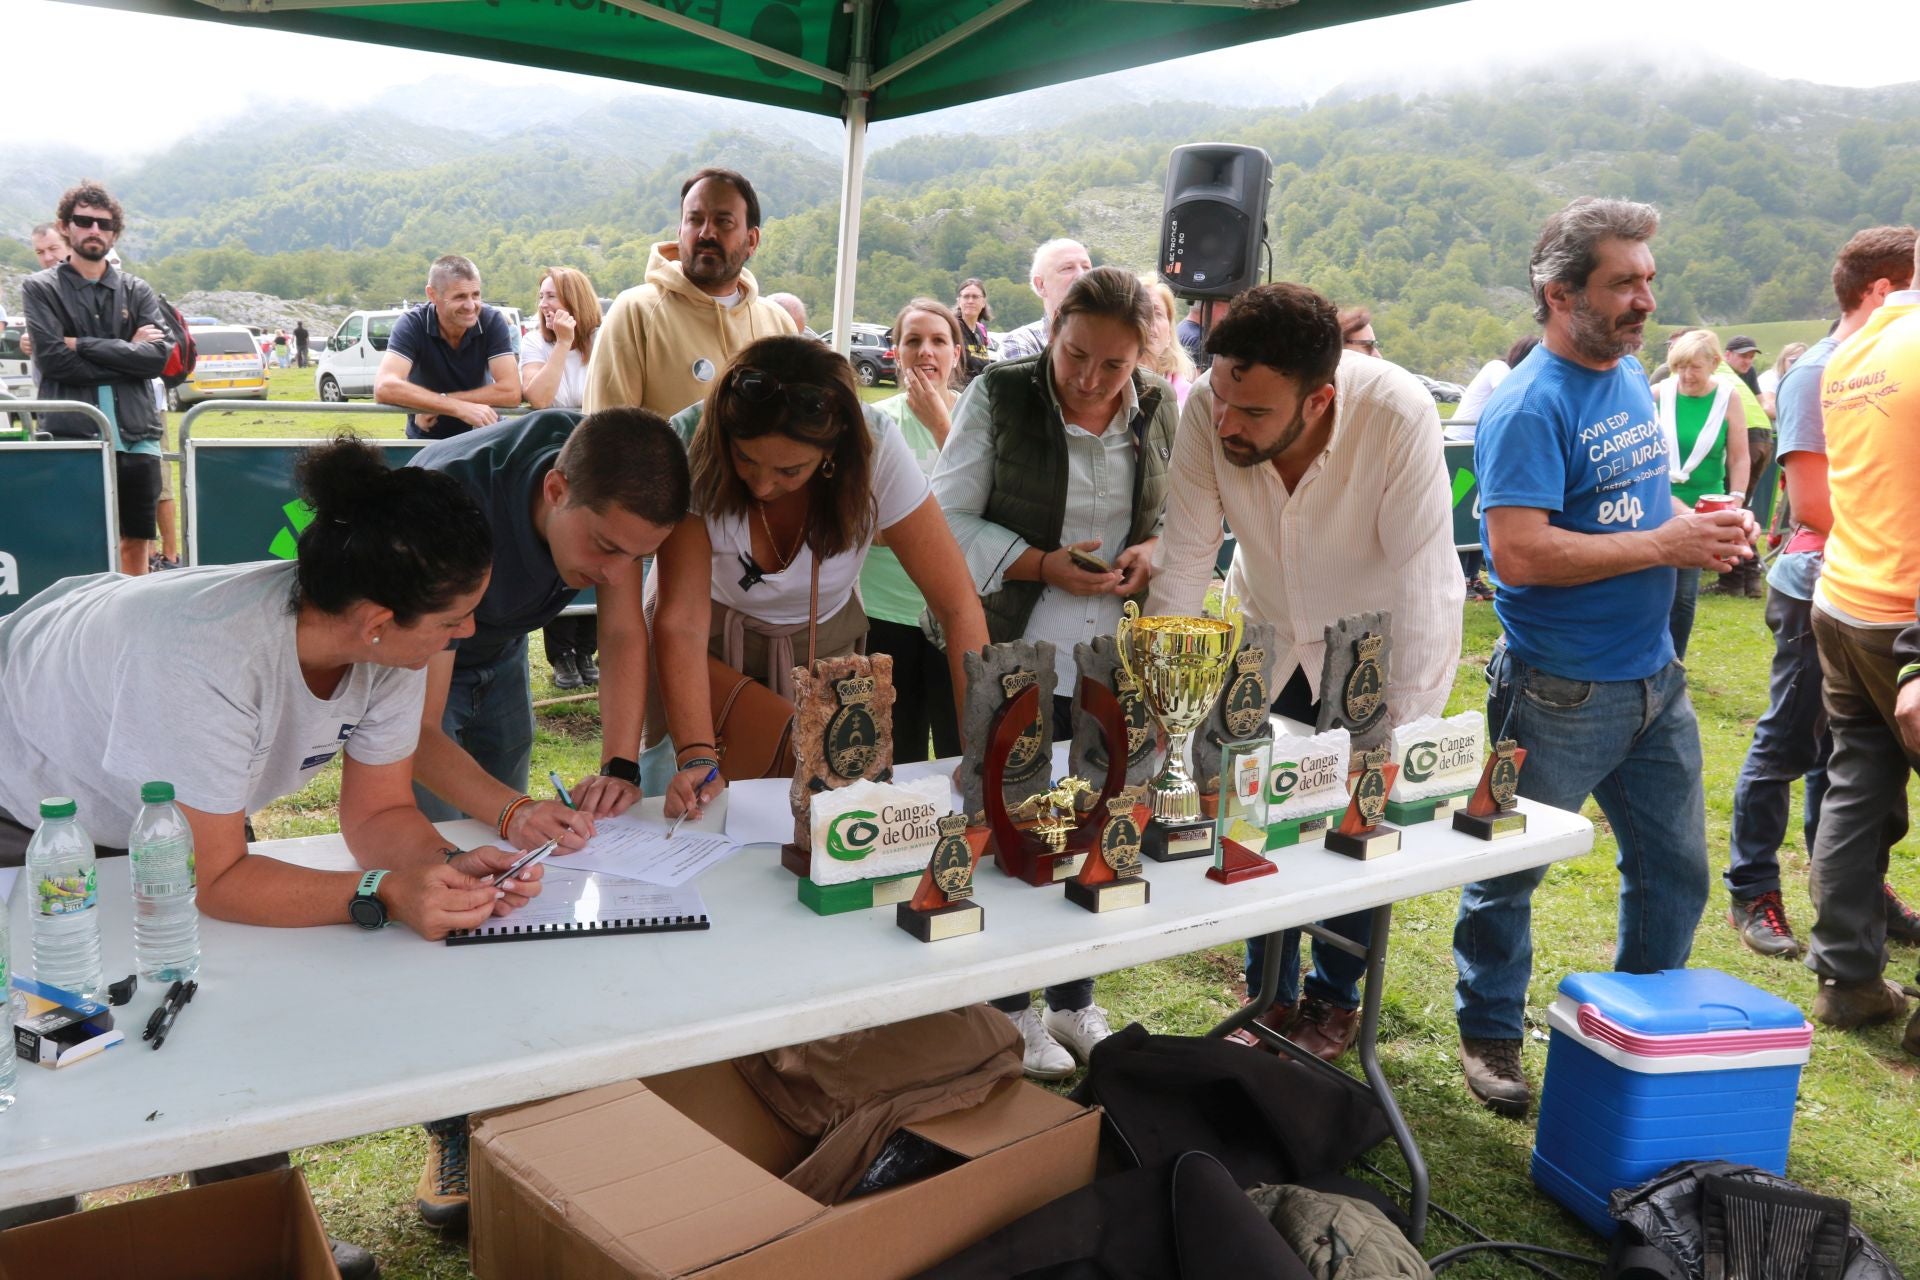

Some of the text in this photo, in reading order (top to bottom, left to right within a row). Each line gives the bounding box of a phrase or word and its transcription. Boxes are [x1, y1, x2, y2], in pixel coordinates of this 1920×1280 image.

[1826, 369, 1886, 394] LOS GUAJES
[1579, 411, 1630, 445] XVII EDP
[1589, 420, 1660, 462] CARRERA
[1596, 455, 1630, 483] DEL
[1597, 491, 1645, 529] edp
[1439, 735, 1475, 752] Cangas
[1301, 753, 1339, 773] Cangas
[1440, 749, 1474, 770] de Onís
[1300, 767, 1338, 791] de Onís
[882, 802, 936, 824] Cangas
[882, 819, 937, 845] de Onís
